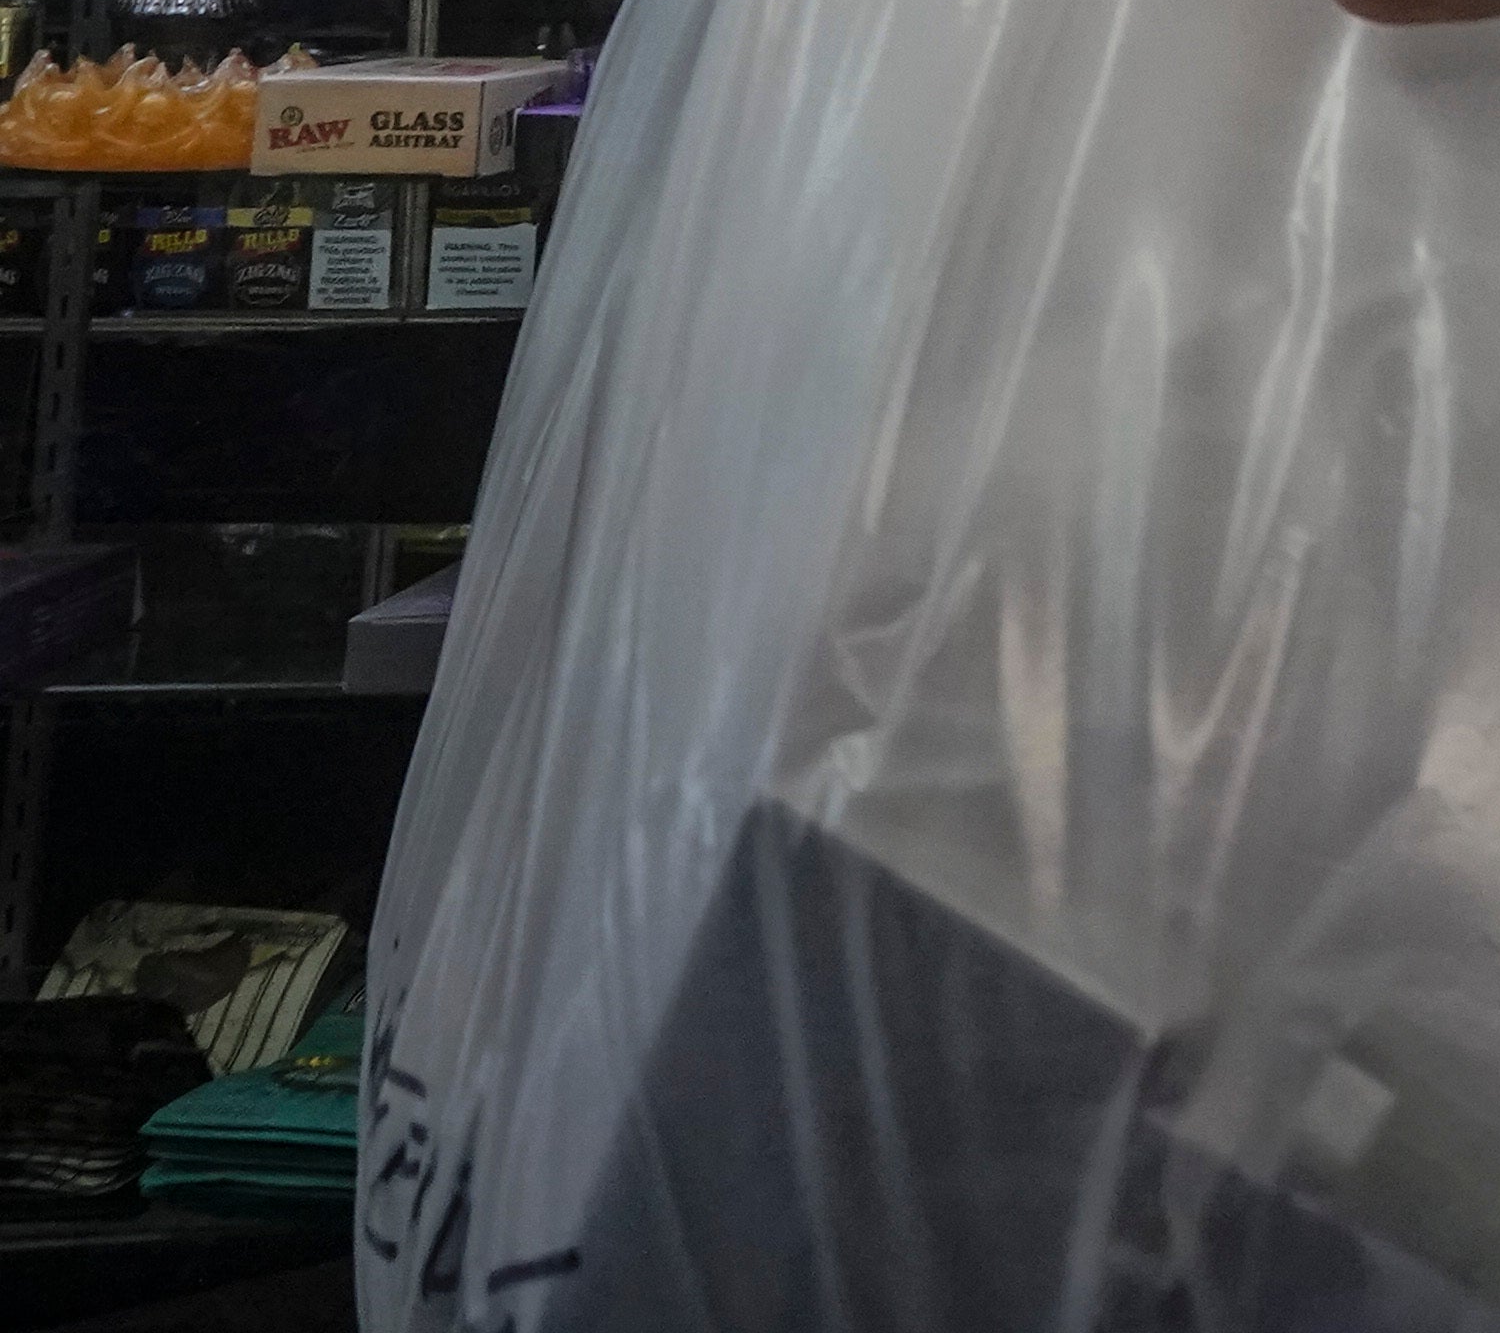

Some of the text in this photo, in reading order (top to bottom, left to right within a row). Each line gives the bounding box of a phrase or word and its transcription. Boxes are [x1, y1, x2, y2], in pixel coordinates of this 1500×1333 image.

[269, 109, 465, 150] RAW GLASS
[368, 133, 465, 149] ASHTRAY
